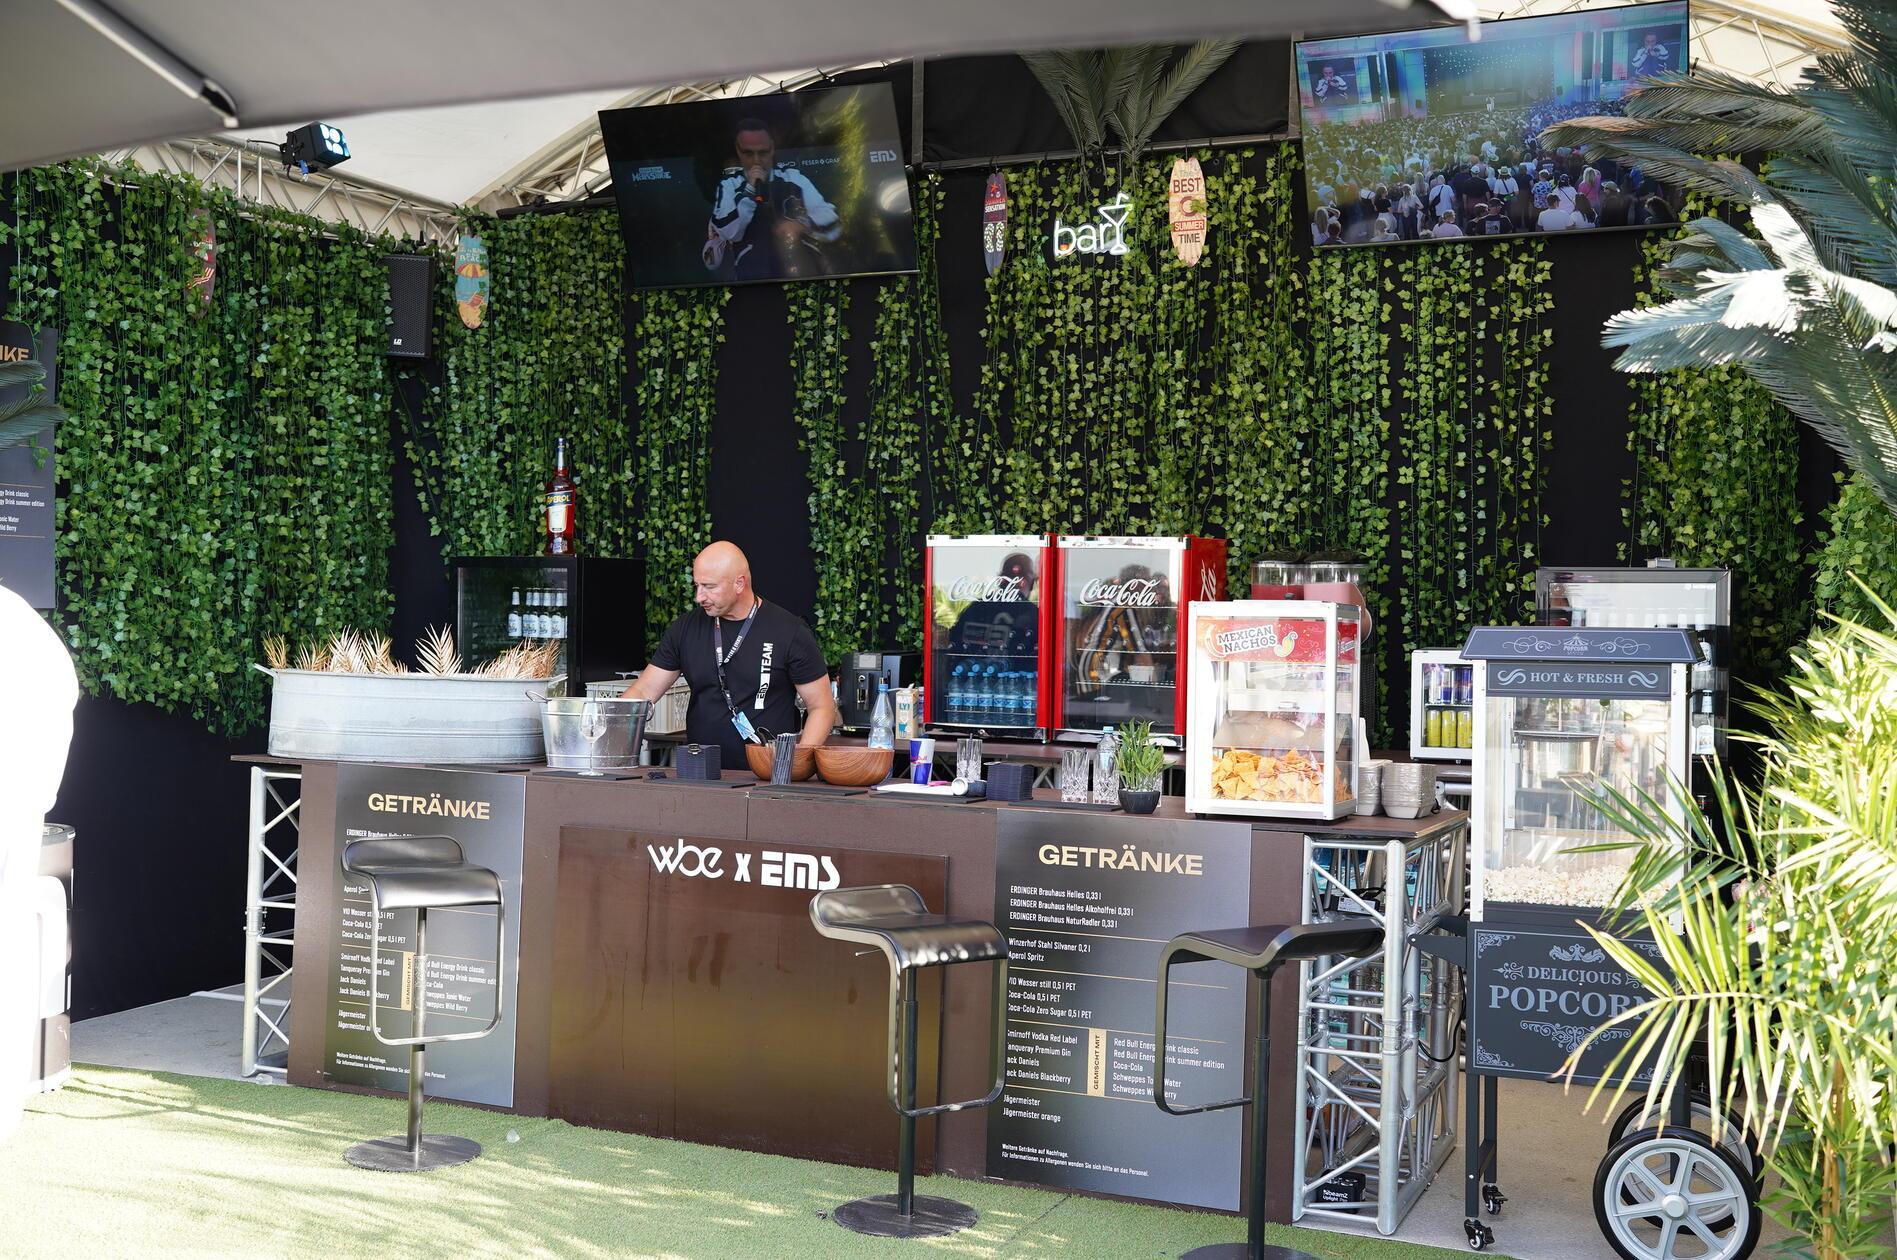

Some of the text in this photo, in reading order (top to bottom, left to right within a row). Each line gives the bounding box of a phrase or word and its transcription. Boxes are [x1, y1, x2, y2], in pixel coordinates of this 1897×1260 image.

[870, 150, 897, 163] EMS
[1173, 178, 1201, 194] BEST
[1174, 221, 1204, 231] SUMMER
[1054, 218, 1112, 254] bar
[1178, 233, 1200, 244] TIME
[951, 576, 1023, 602] Coca-Cola
[1080, 578, 1160, 607] Coca-Cola
[1218, 626, 1272, 644] MEXICAN
[1224, 635, 1276, 653] NACHOS
[761, 643, 774, 674] TEAM
[1530, 672, 1624, 684] HOT & FRESH
[368, 793, 490, 820] GETRÄNKE
[1038, 844, 1204, 876] GETRÄNKE
[761, 850, 841, 891] EMS
[1010, 885, 1098, 900] ERDINGER Brauhaus Helles 0,33
[1010, 898, 1130, 916] ERDINGER Brauhaus Helles Alkoholfrei 0,33
[1010, 912, 1114, 928] ERDINGER Brauhaus NaturRadler 0,33
[1008, 938, 1087, 953] Winzerhof Stahl Silvaner 0,2
[1008, 951, 1044, 961] Aperol Spritz
[1528, 966, 1622, 985] DELICIOUS
[1018, 978, 1038, 988] Wasser
[1040, 980, 1051, 989] still
[1053, 981, 1061, 990] 0,5
[1037, 993, 1046, 1002] 0,5
[1050, 994, 1060, 1002] PET
[1036, 1007, 1048, 1015] Zero
[1050, 1007, 1066, 1017] Sugar
[1068, 1009, 1076, 1018] 0,5
[1081, 1010, 1092, 1019] PET
[1032, 1032, 1048, 1041] Vodka
[1050, 1034, 1061, 1042] Red
[1062, 1036, 1078, 1044] Label
[1008, 1042, 1034, 1054] anqueray
[1035, 1046, 1060, 1056] Premium
[1114, 1038, 1125, 1047] Red
[1127, 1040, 1138, 1048] Bull
[1140, 1041, 1155, 1052] Energ
[1178, 1045, 1199, 1054] classic
[1018, 1057, 1039, 1066] Daniels
[1114, 1050, 1125, 1058] Red
[1126, 1051, 1138, 1060] Bull
[1140, 1052, 1155, 1063] Energ
[1177, 1058, 1201, 1066] summer
[1203, 1060, 1224, 1069] edition
[1114, 1061, 1143, 1071] Coca-Cola
[1018, 1070, 1039, 1080] Daniels
[1040, 1072, 1071, 1084] Blackberry
[1113, 1073, 1145, 1084] Schweppes
[1113, 1084, 1176, 1100] Schweppes erry
[1004, 1095, 1040, 1106] Jägermeister
[1003, 1108, 1061, 1123] Jägermeister orange
[1019, 1146, 1037, 1154] Getränke
[1046, 1149, 1069, 1158] Nachfrage.
[1010, 1152, 1039, 1162] Informationen
[1045, 1157, 1067, 1166] Allergenen
[1129, 1168, 1149, 1176] Personal.
